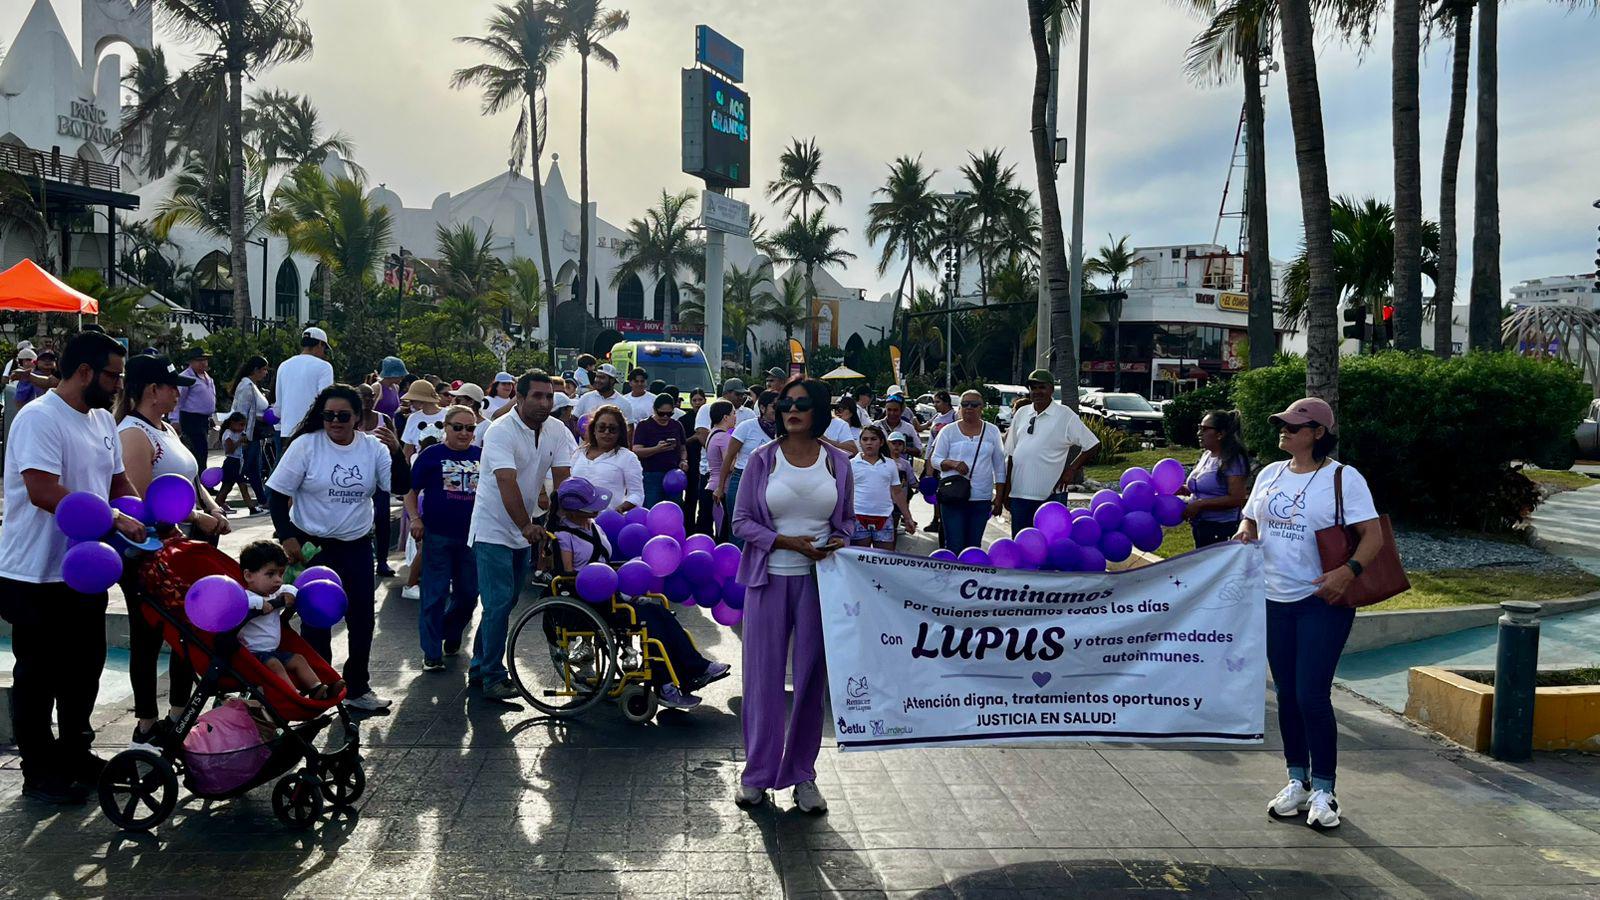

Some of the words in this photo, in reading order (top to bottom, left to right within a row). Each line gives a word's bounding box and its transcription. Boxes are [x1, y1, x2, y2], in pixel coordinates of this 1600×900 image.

[328, 488, 365, 497] Renacer
[1268, 520, 1307, 532] Renacer
[1281, 529, 1305, 541] Lupus
[857, 553, 997, 575] #LEYLUPUSYAUTOINMUNES
[960, 578, 1114, 604] Caminamos
[904, 600, 928, 611] Por
[932, 606, 989, 618] quienes
[992, 607, 1063, 616] luchamos
[1067, 603, 1108, 615] todos
[1111, 602, 1134, 614] los
[1138, 598, 1169, 613] días
[880, 632, 903, 646] Con
[911, 621, 1065, 661] LUPUS
[1073, 637, 1082, 649] y
[1086, 635, 1123, 647] otras
[1127, 630, 1233, 645] enfermedades
[1102, 650, 1204, 663] autoinmunes.
[846, 698, 871, 706] Renacer
[903, 693, 960, 713] ¡Atención
[963, 693, 1008, 709] digna,
[1012, 691, 1109, 705] tratamientos
[1112, 693, 1190, 707] oportunos
[1194, 698, 1203, 710] y
[977, 712, 1037, 727] JUSTICIA
[1040, 712, 1060, 724] EN
[1063, 711, 1116, 724] SALUD!
[839, 723, 866, 734] Cetlu
